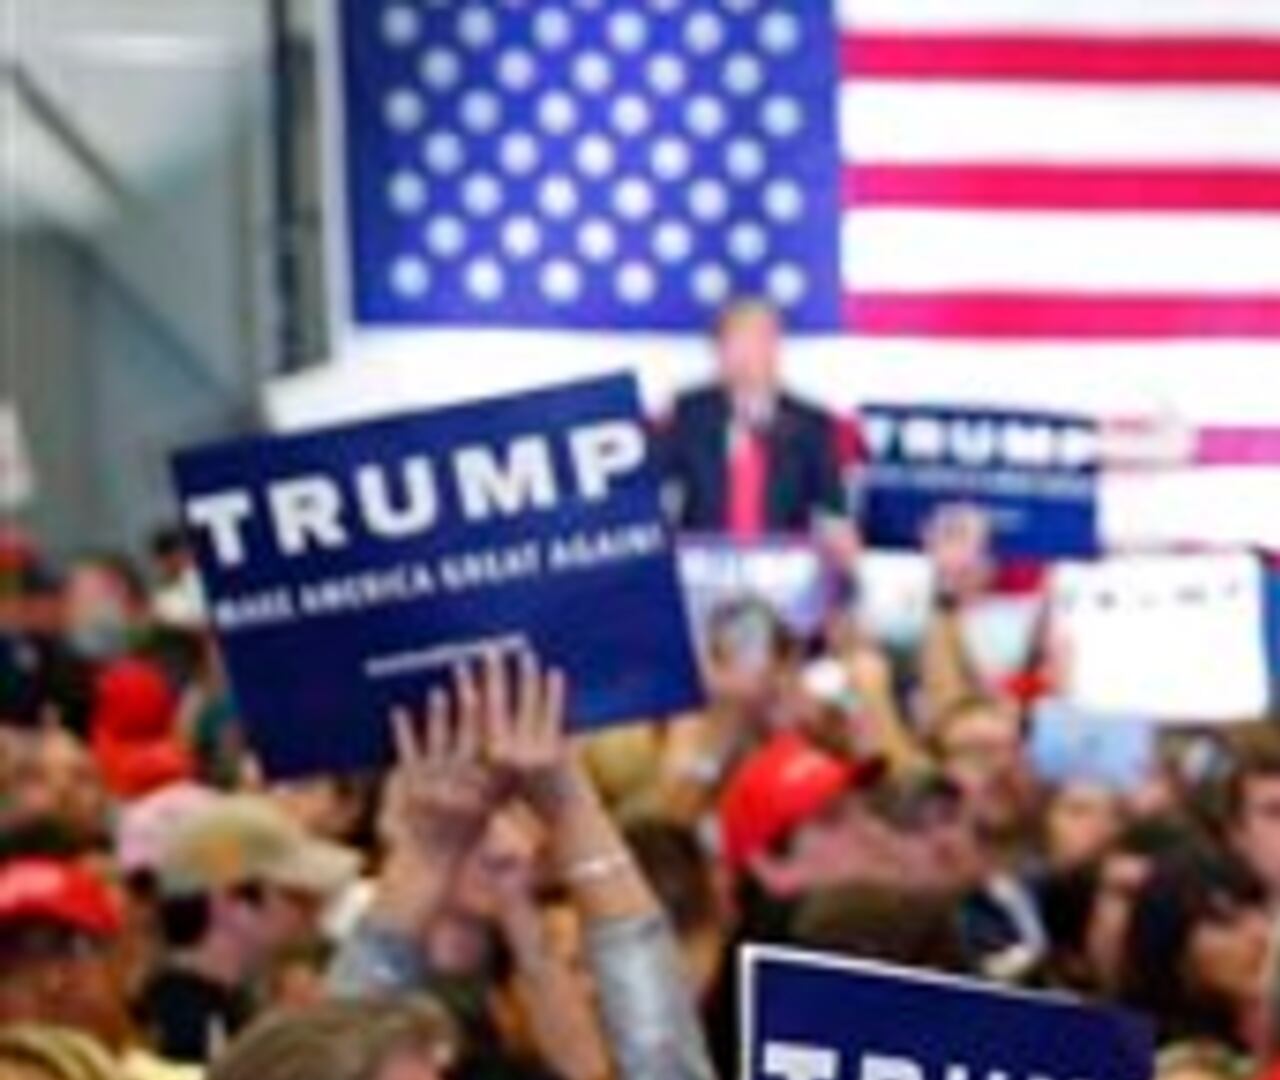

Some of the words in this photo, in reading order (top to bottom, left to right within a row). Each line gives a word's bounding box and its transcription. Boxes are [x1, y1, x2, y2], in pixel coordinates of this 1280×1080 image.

[187, 419, 646, 566] TRUMP
[300, 563, 434, 615] AMERICA
[440, 541, 540, 591] GREAT
